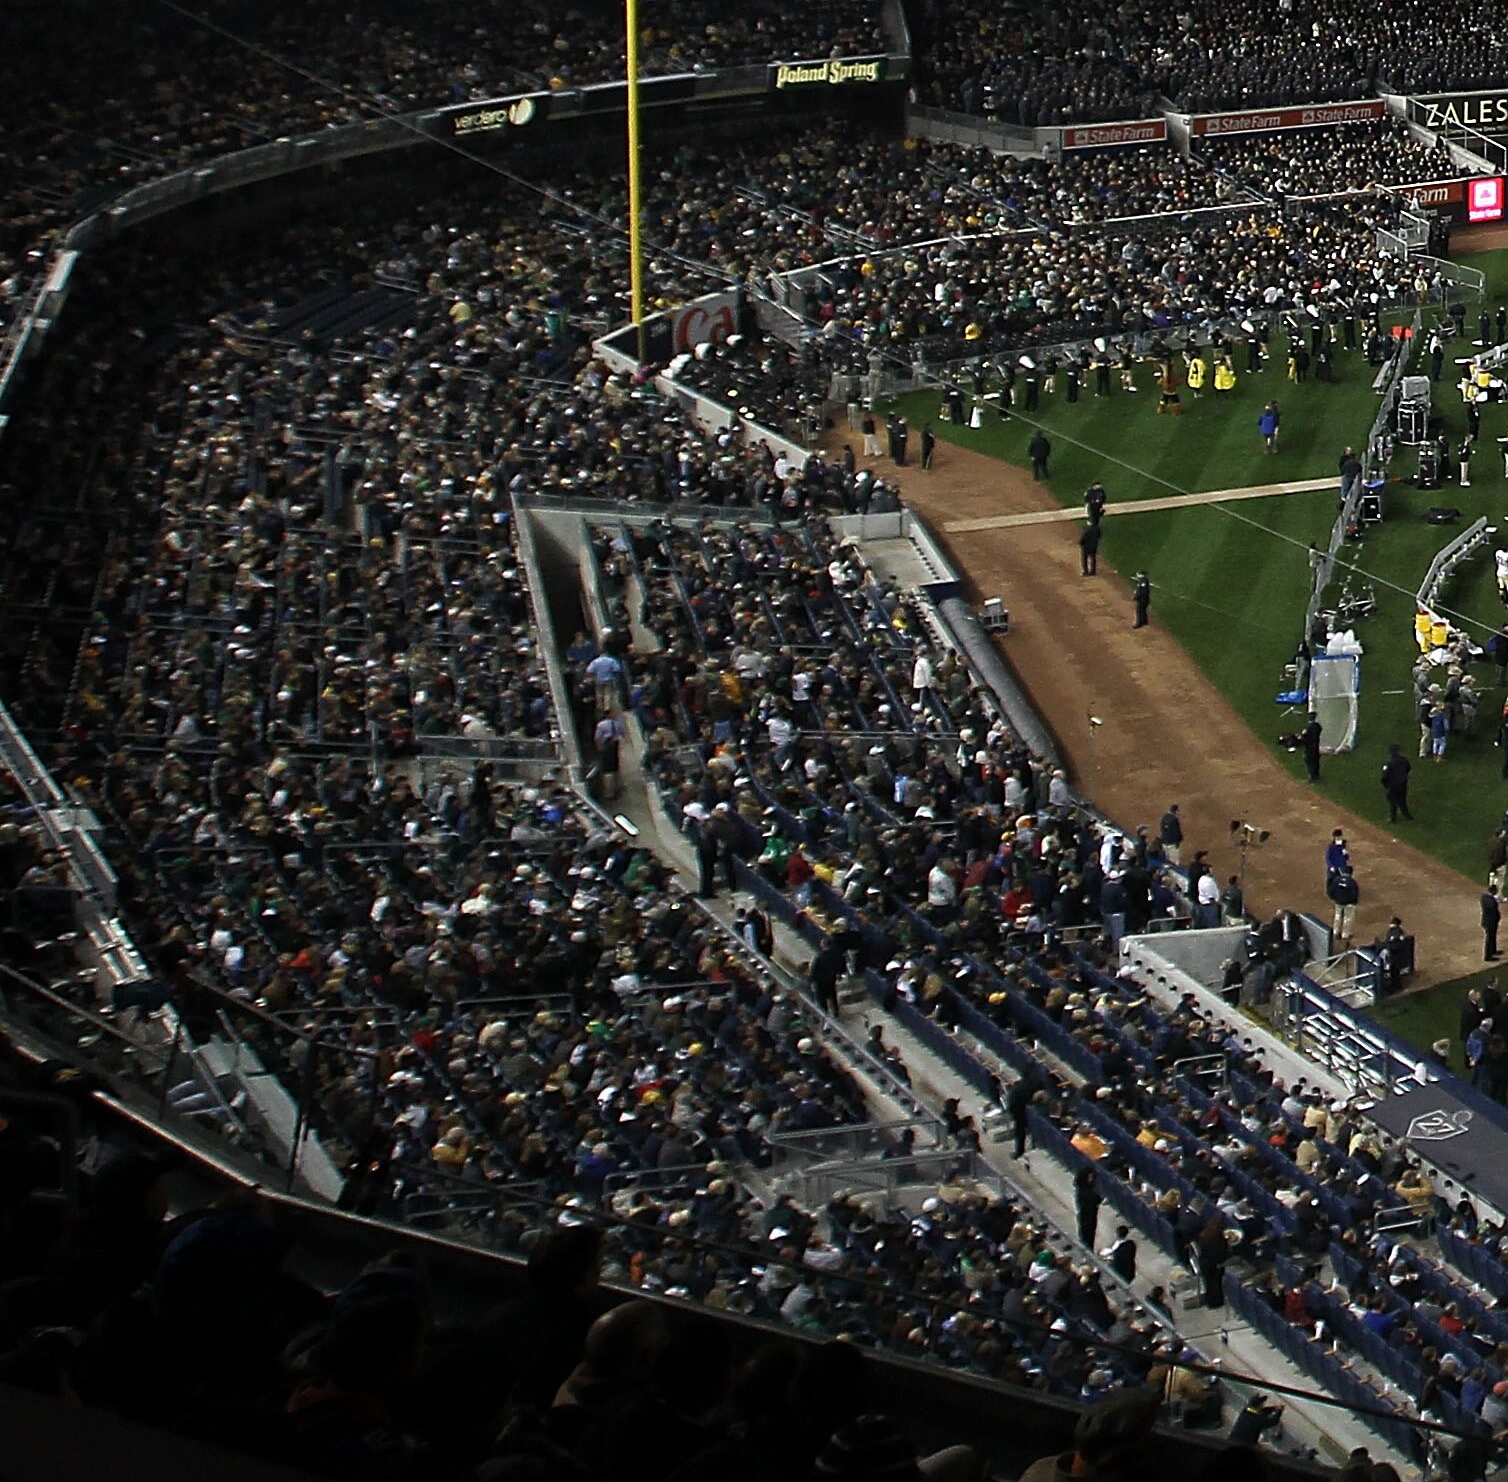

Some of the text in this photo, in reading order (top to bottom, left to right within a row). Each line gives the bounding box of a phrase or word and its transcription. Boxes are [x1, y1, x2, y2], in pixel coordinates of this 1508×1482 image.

[776, 61, 879, 88] Poland Spring
[1315, 106, 1371, 122] State Farm
[1427, 99, 1508, 127] ZALES
[1220, 115, 1280, 131] State Farm
[1090, 127, 1154, 142] State Farm
[1414, 186, 1448, 202] Farm
